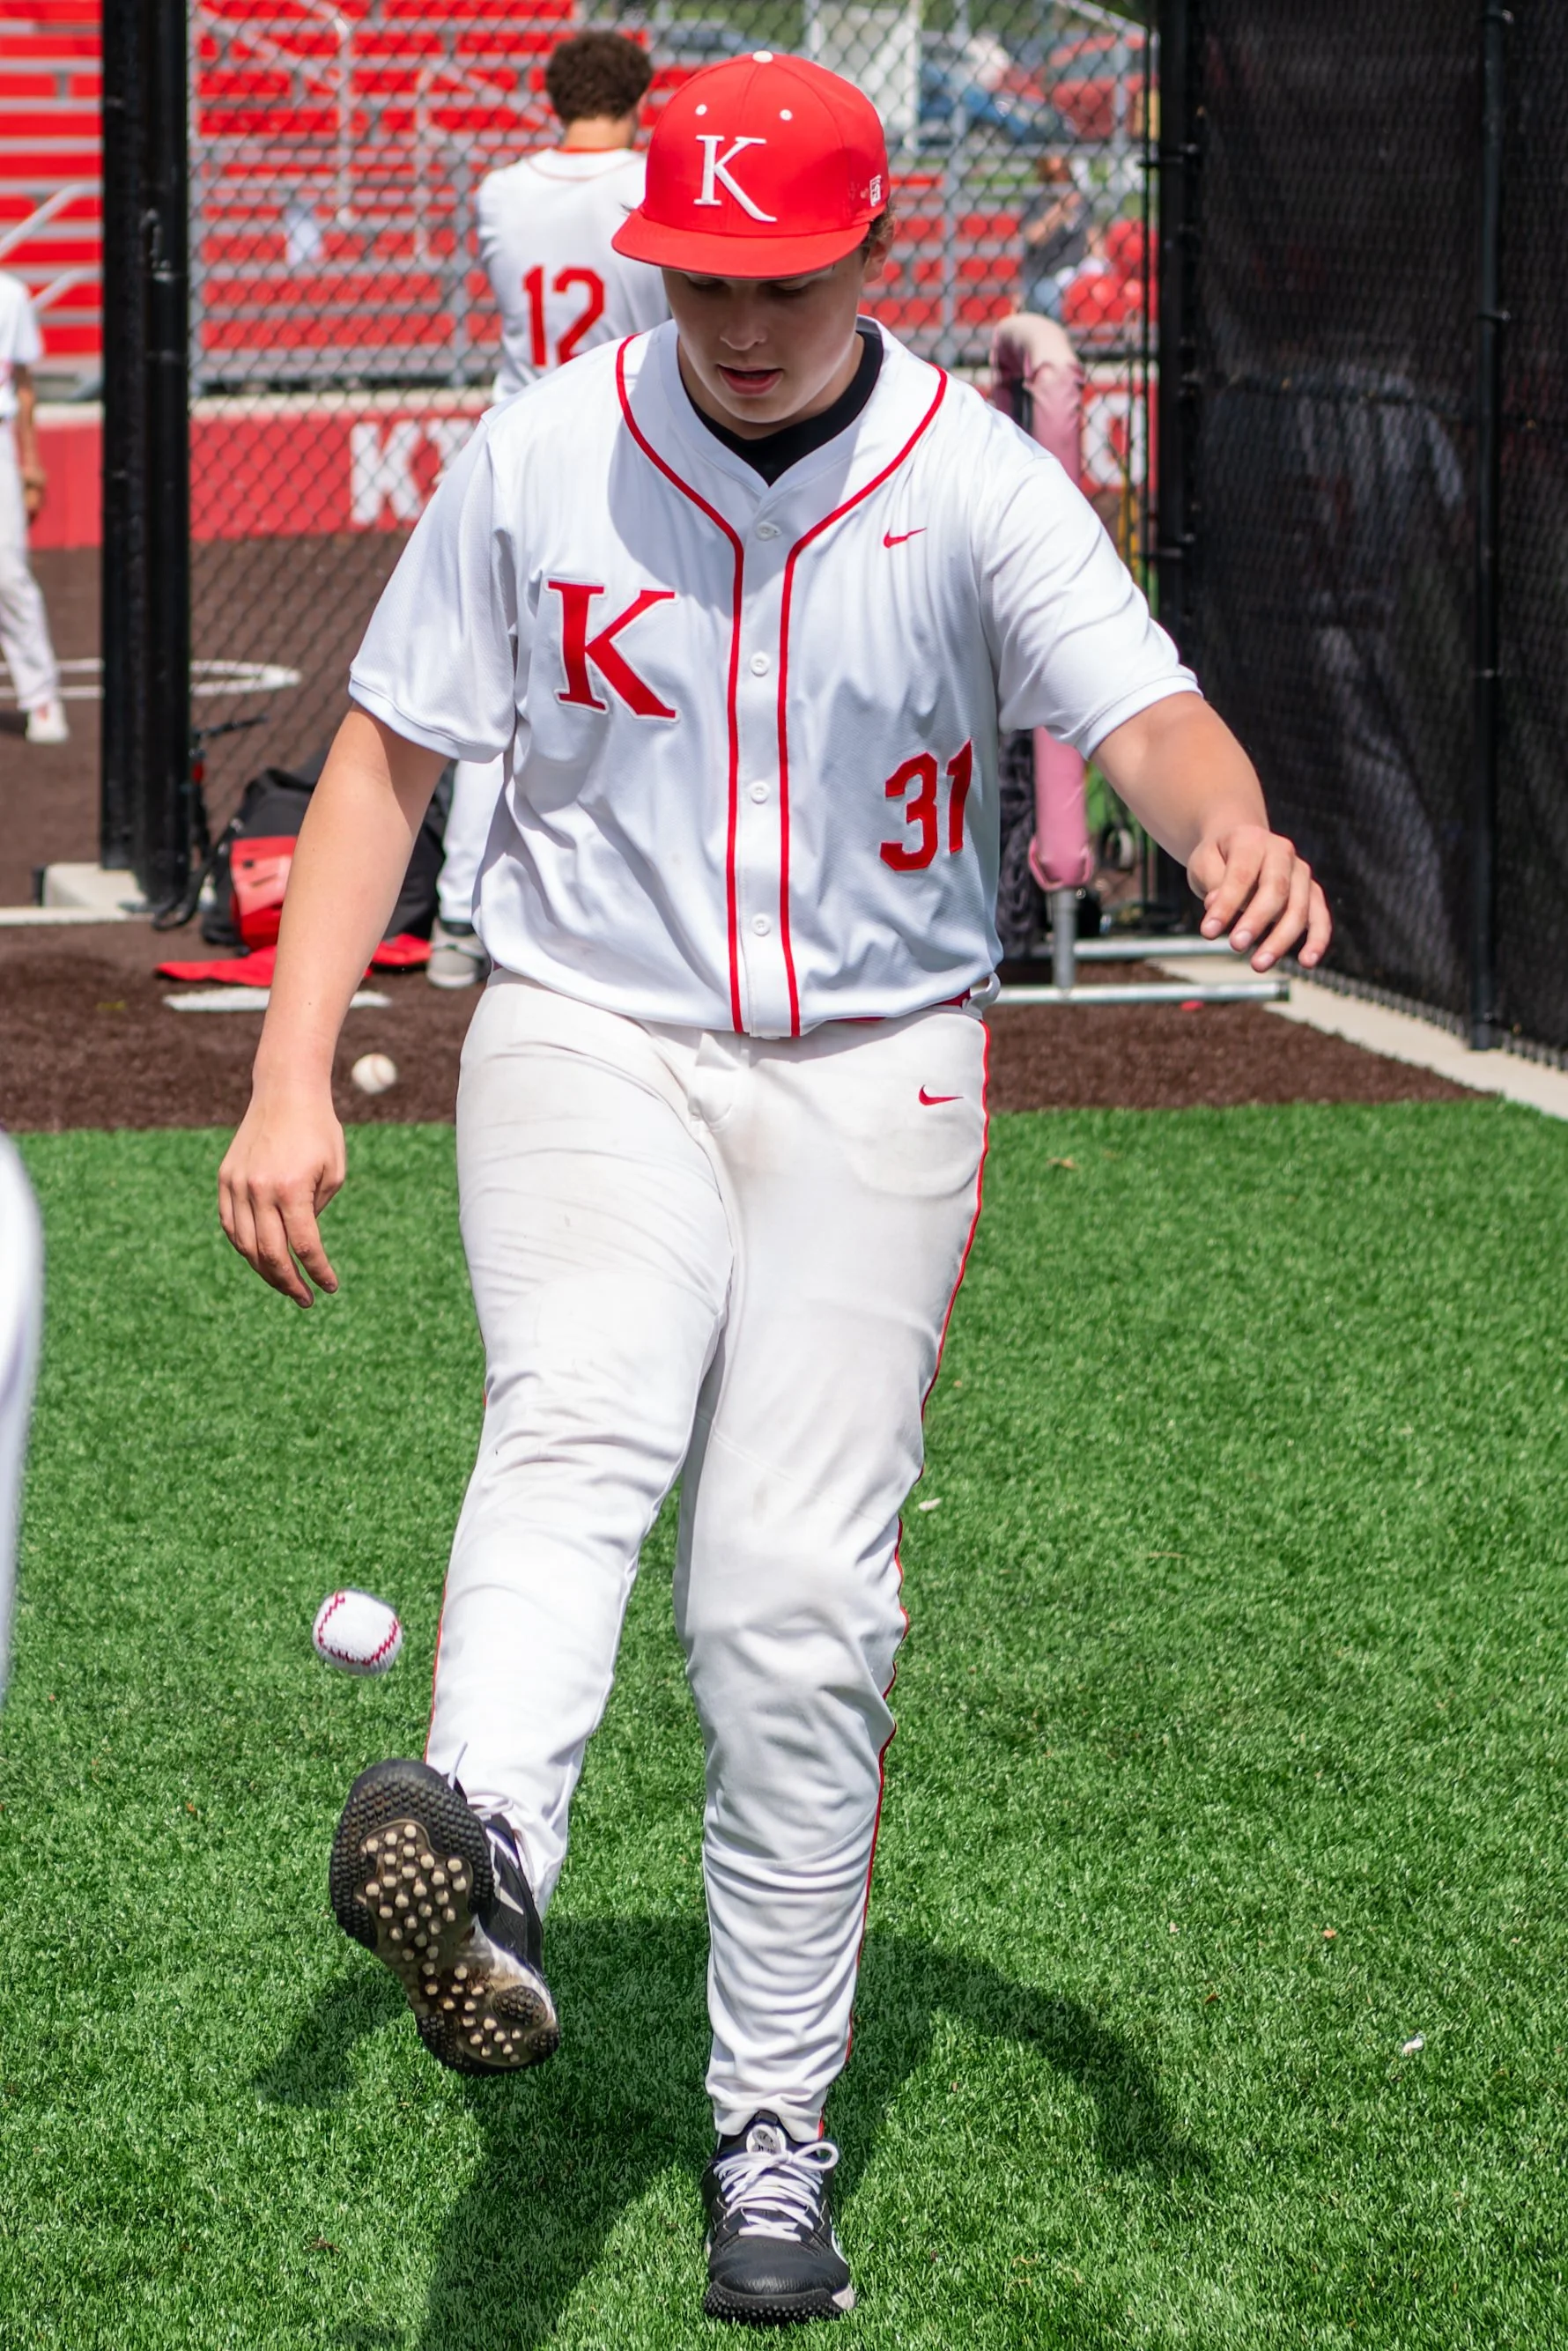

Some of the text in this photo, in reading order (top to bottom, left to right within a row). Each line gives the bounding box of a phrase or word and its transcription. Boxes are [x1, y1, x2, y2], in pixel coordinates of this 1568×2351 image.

[693, 134, 778, 222] K
[523, 264, 604, 366] 12
[547, 579, 677, 721] K
[879, 736, 973, 871] 31
